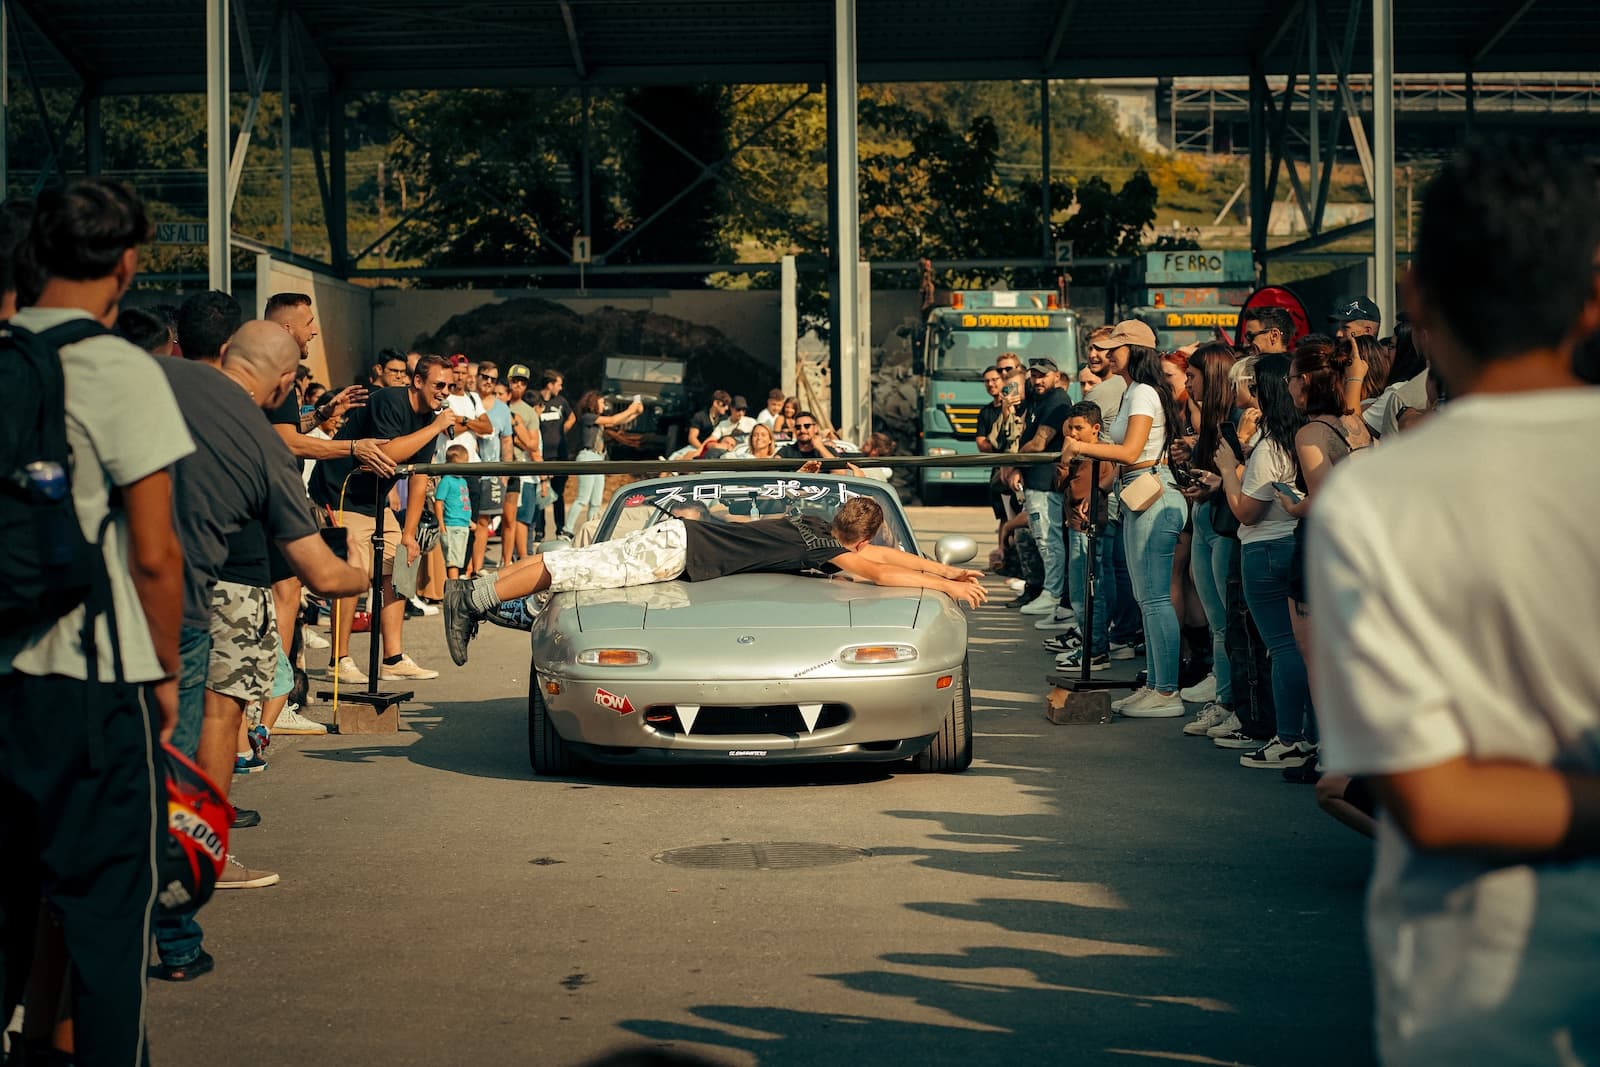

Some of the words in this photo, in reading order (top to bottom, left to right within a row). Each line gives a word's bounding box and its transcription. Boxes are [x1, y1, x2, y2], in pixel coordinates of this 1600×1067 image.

[156, 224, 208, 242] ASFALTO
[579, 241, 585, 258] 1
[1059, 246, 1070, 262] 2
[1164, 253, 1222, 272] FERRO
[654, 479, 861, 504] スローポット
[594, 693, 625, 709] TOW
